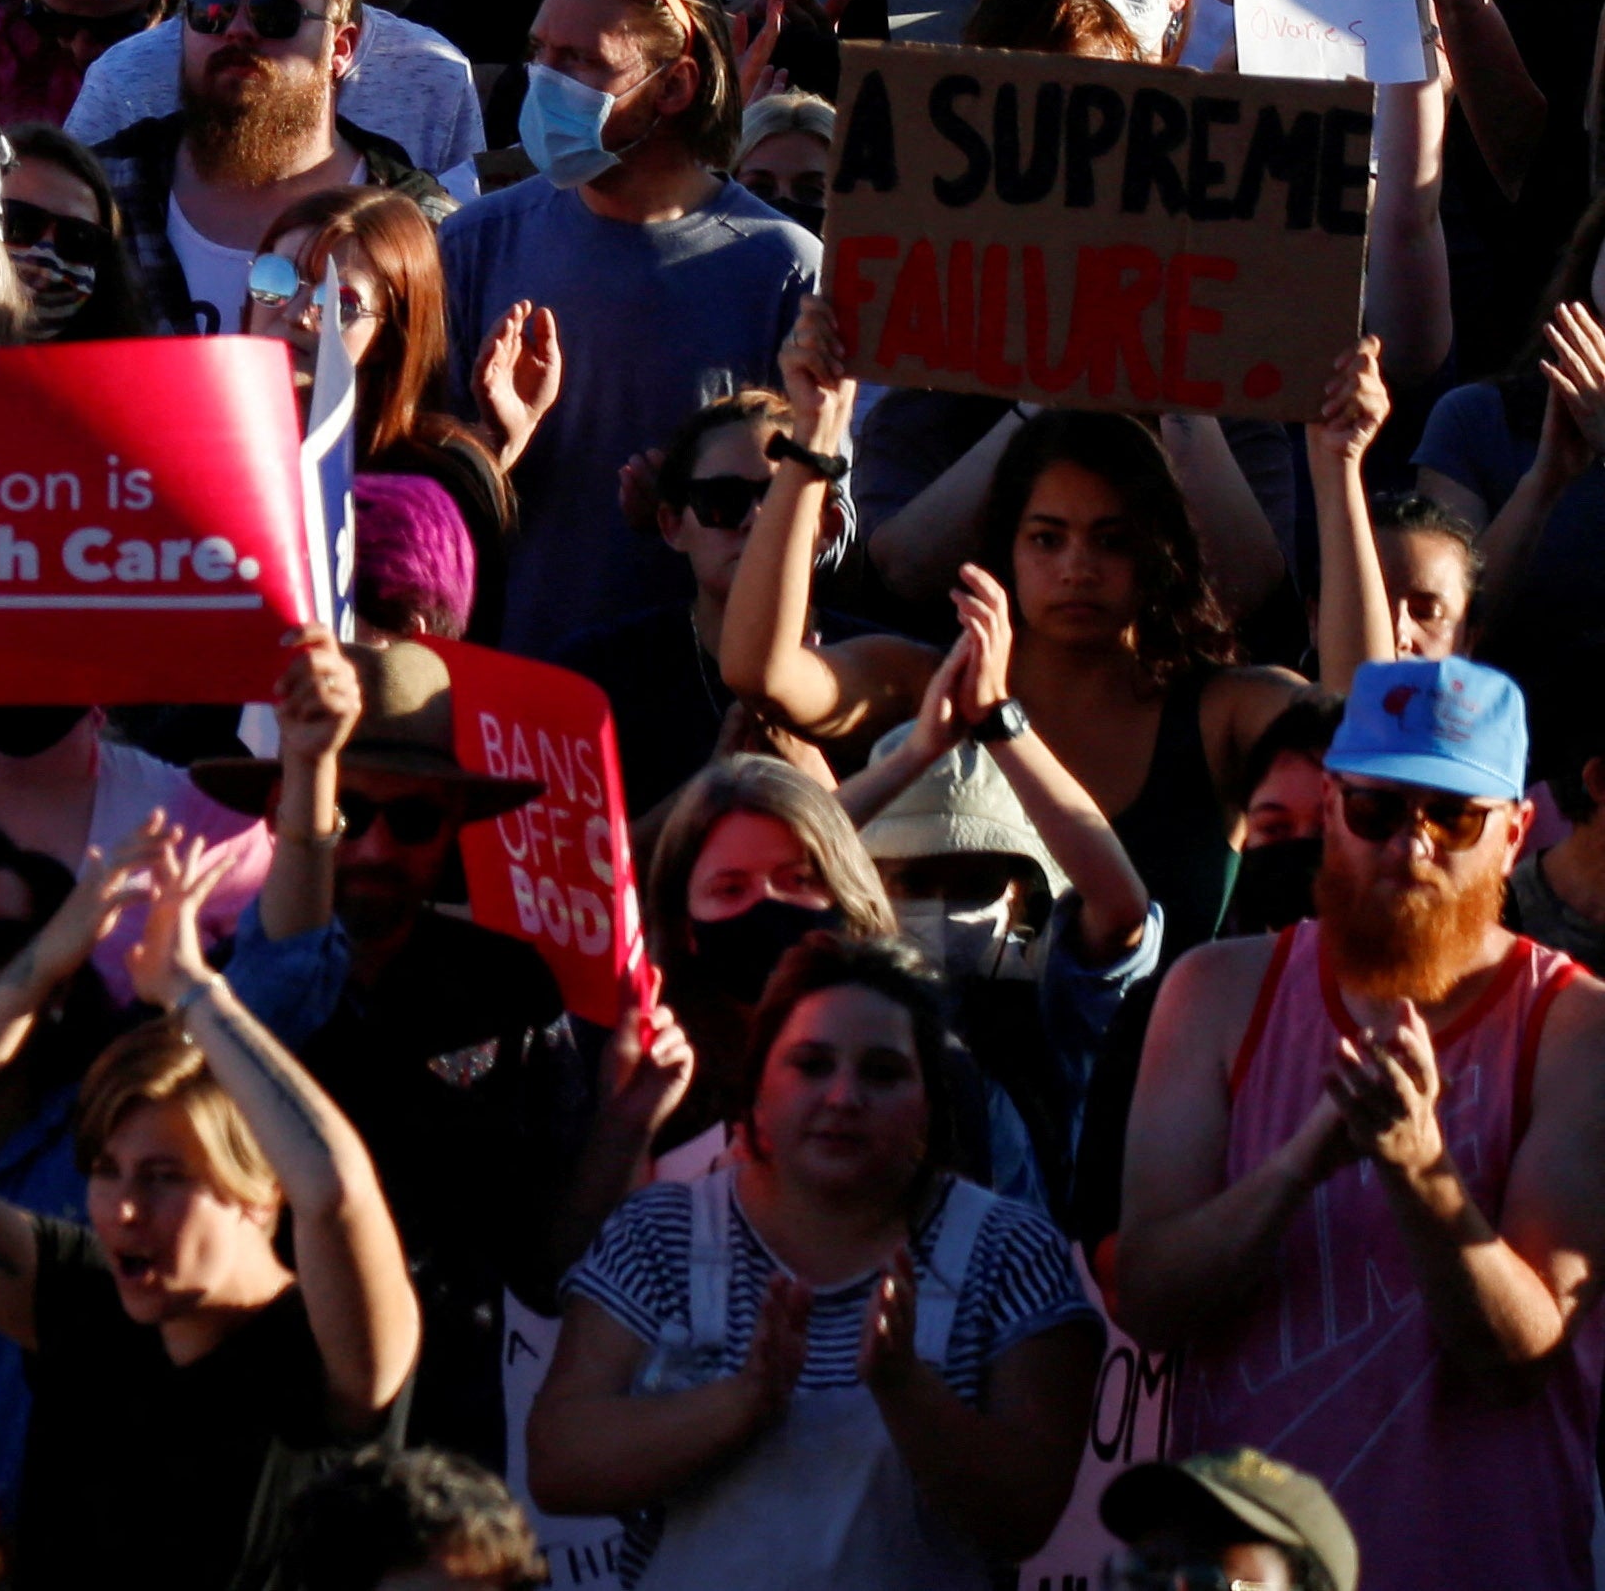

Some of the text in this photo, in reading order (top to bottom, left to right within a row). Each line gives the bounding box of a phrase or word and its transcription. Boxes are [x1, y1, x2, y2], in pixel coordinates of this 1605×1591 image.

[1250, 8, 1367, 46] Ovaries
[831, 70, 1373, 237] A SUPREME
[831, 234, 1284, 409] FAILURE.
[105, 454, 154, 510] is
[62, 526, 261, 583] Care.
[479, 712, 604, 810] BANS
[496, 803, 573, 873] OFF
[509, 864, 617, 957] BOD
